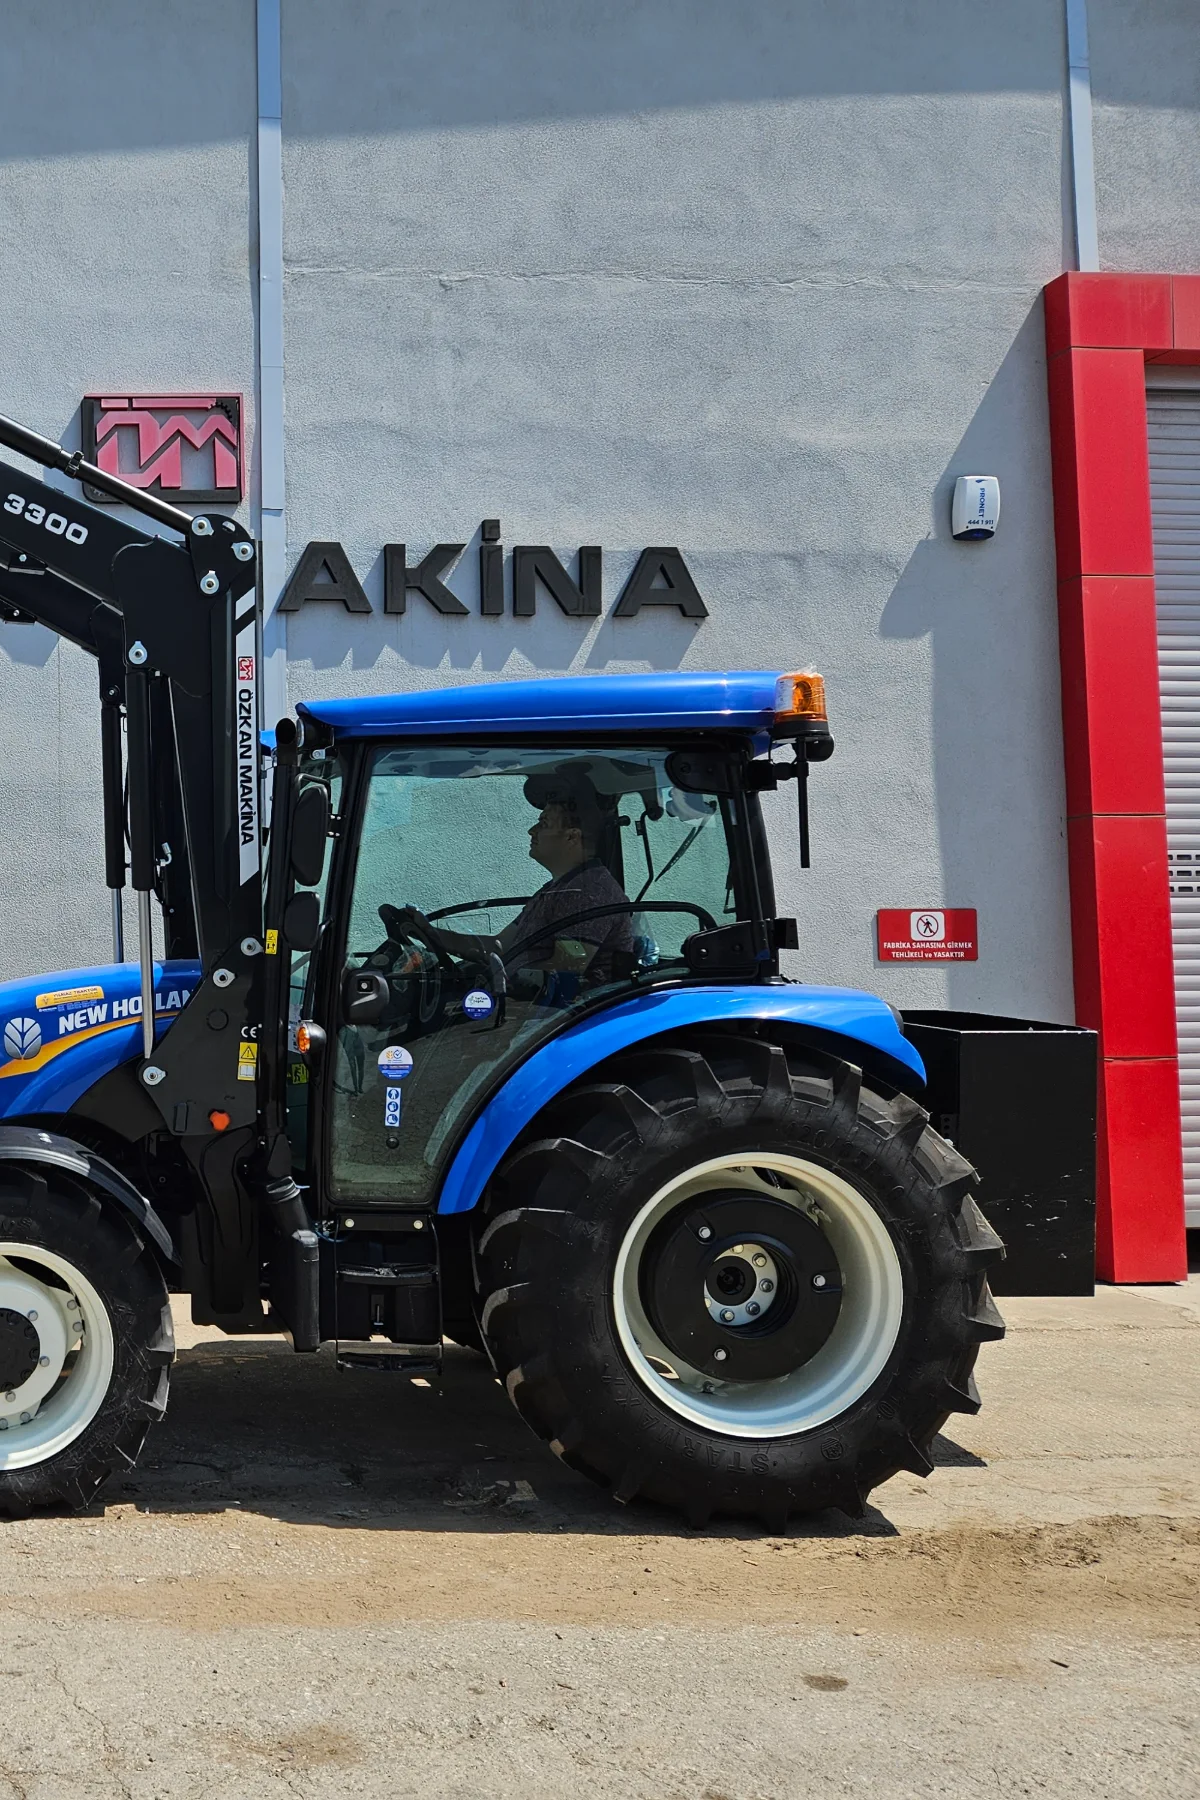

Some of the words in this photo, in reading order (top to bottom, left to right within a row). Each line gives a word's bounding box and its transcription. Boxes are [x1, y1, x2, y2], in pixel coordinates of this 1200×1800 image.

[3, 493, 89, 545] 3300
[277, 519, 709, 617] AKİNA
[238, 688, 254, 760] ÖZKAN
[239, 764, 257, 847] MAKİNA
[883, 940, 912, 949] FABRİKA
[911, 941, 946, 949] SAHASINA
[947, 940, 973, 949] GİRMEK
[891, 950, 924, 958] TEHLİKELİ
[58, 1001, 108, 1035] NEW
[112, 989, 191, 1019] HOLA
